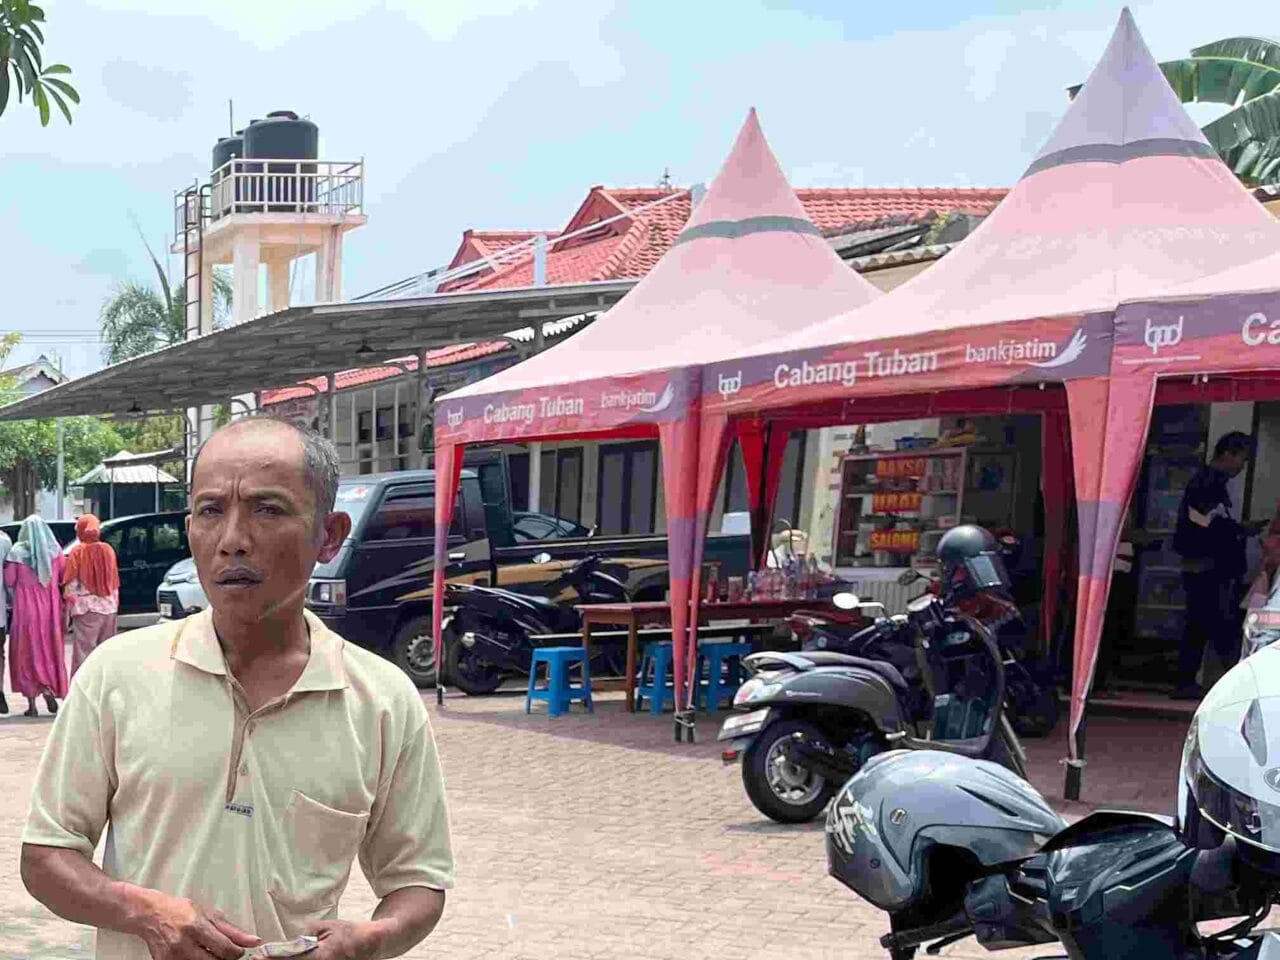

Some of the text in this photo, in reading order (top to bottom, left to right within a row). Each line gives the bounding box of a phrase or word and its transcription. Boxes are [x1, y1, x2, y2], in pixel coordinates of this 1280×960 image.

[965, 338, 1057, 364] bankjatim
[774, 348, 938, 389] Cabang Tuban
[483, 396, 584, 425] Cabang Tuban
[601, 389, 656, 409] bankjatim
